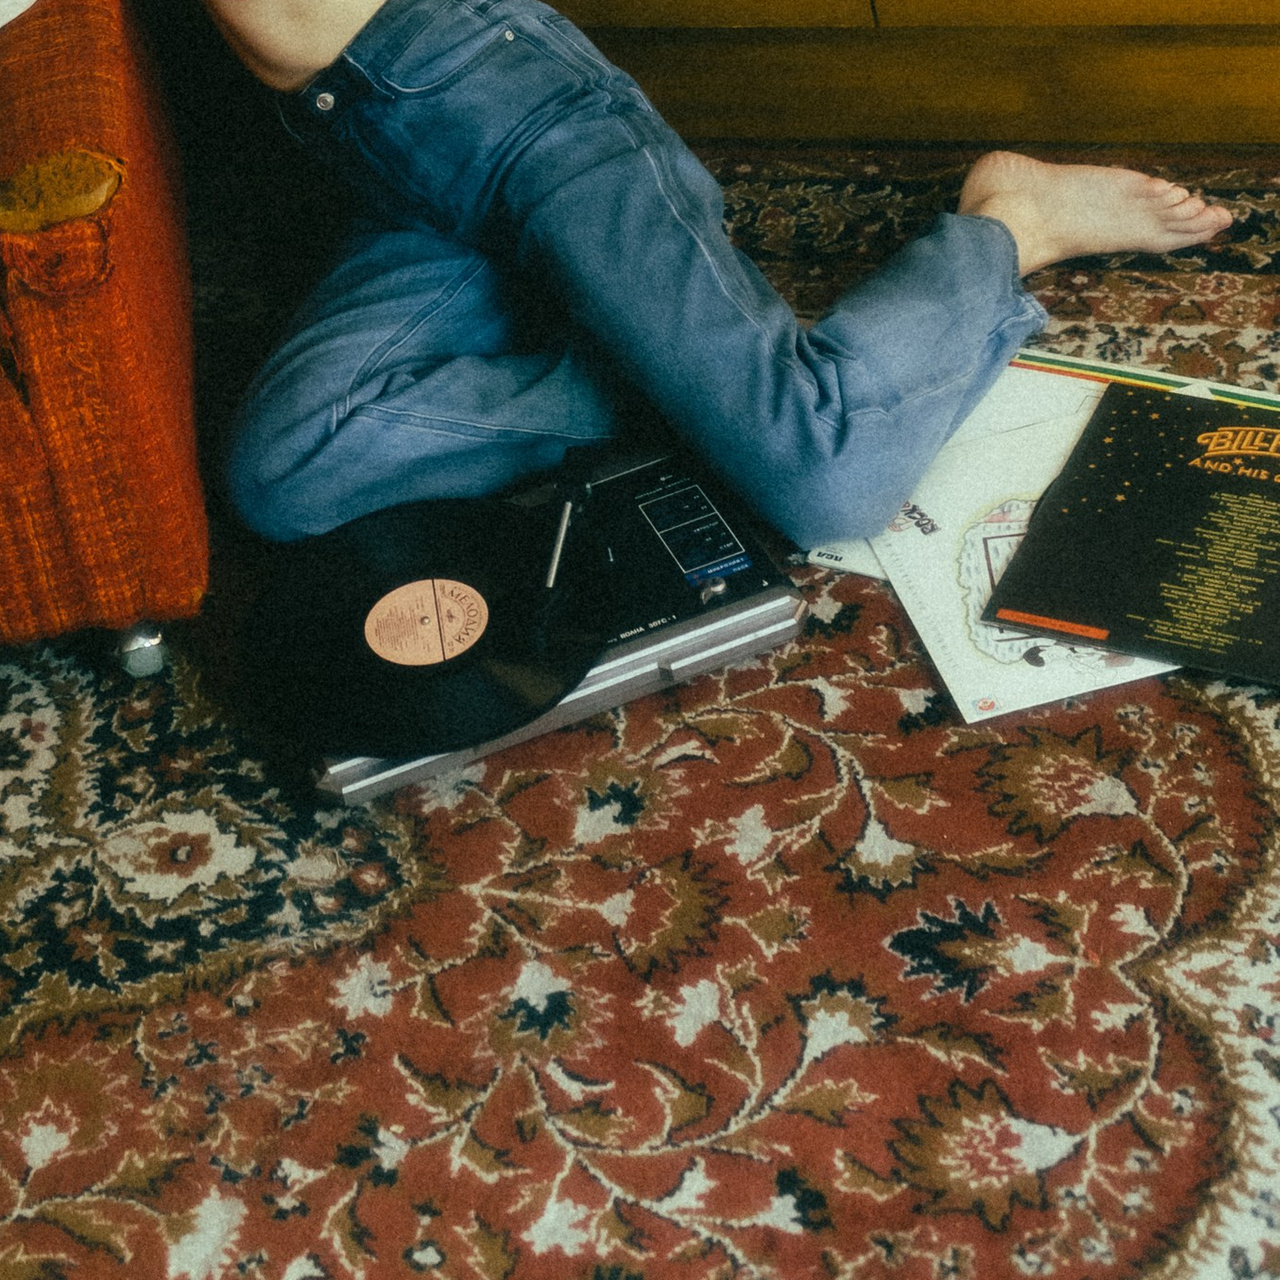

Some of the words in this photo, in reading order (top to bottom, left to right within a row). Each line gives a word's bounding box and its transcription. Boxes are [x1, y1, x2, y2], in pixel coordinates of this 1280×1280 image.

[1189, 456, 1233, 475] AND
[1238, 465, 1272, 482] HIS
[816, 549, 845, 563] RCA
[449, 585, 478, 644] МЕЛОДИЯ
